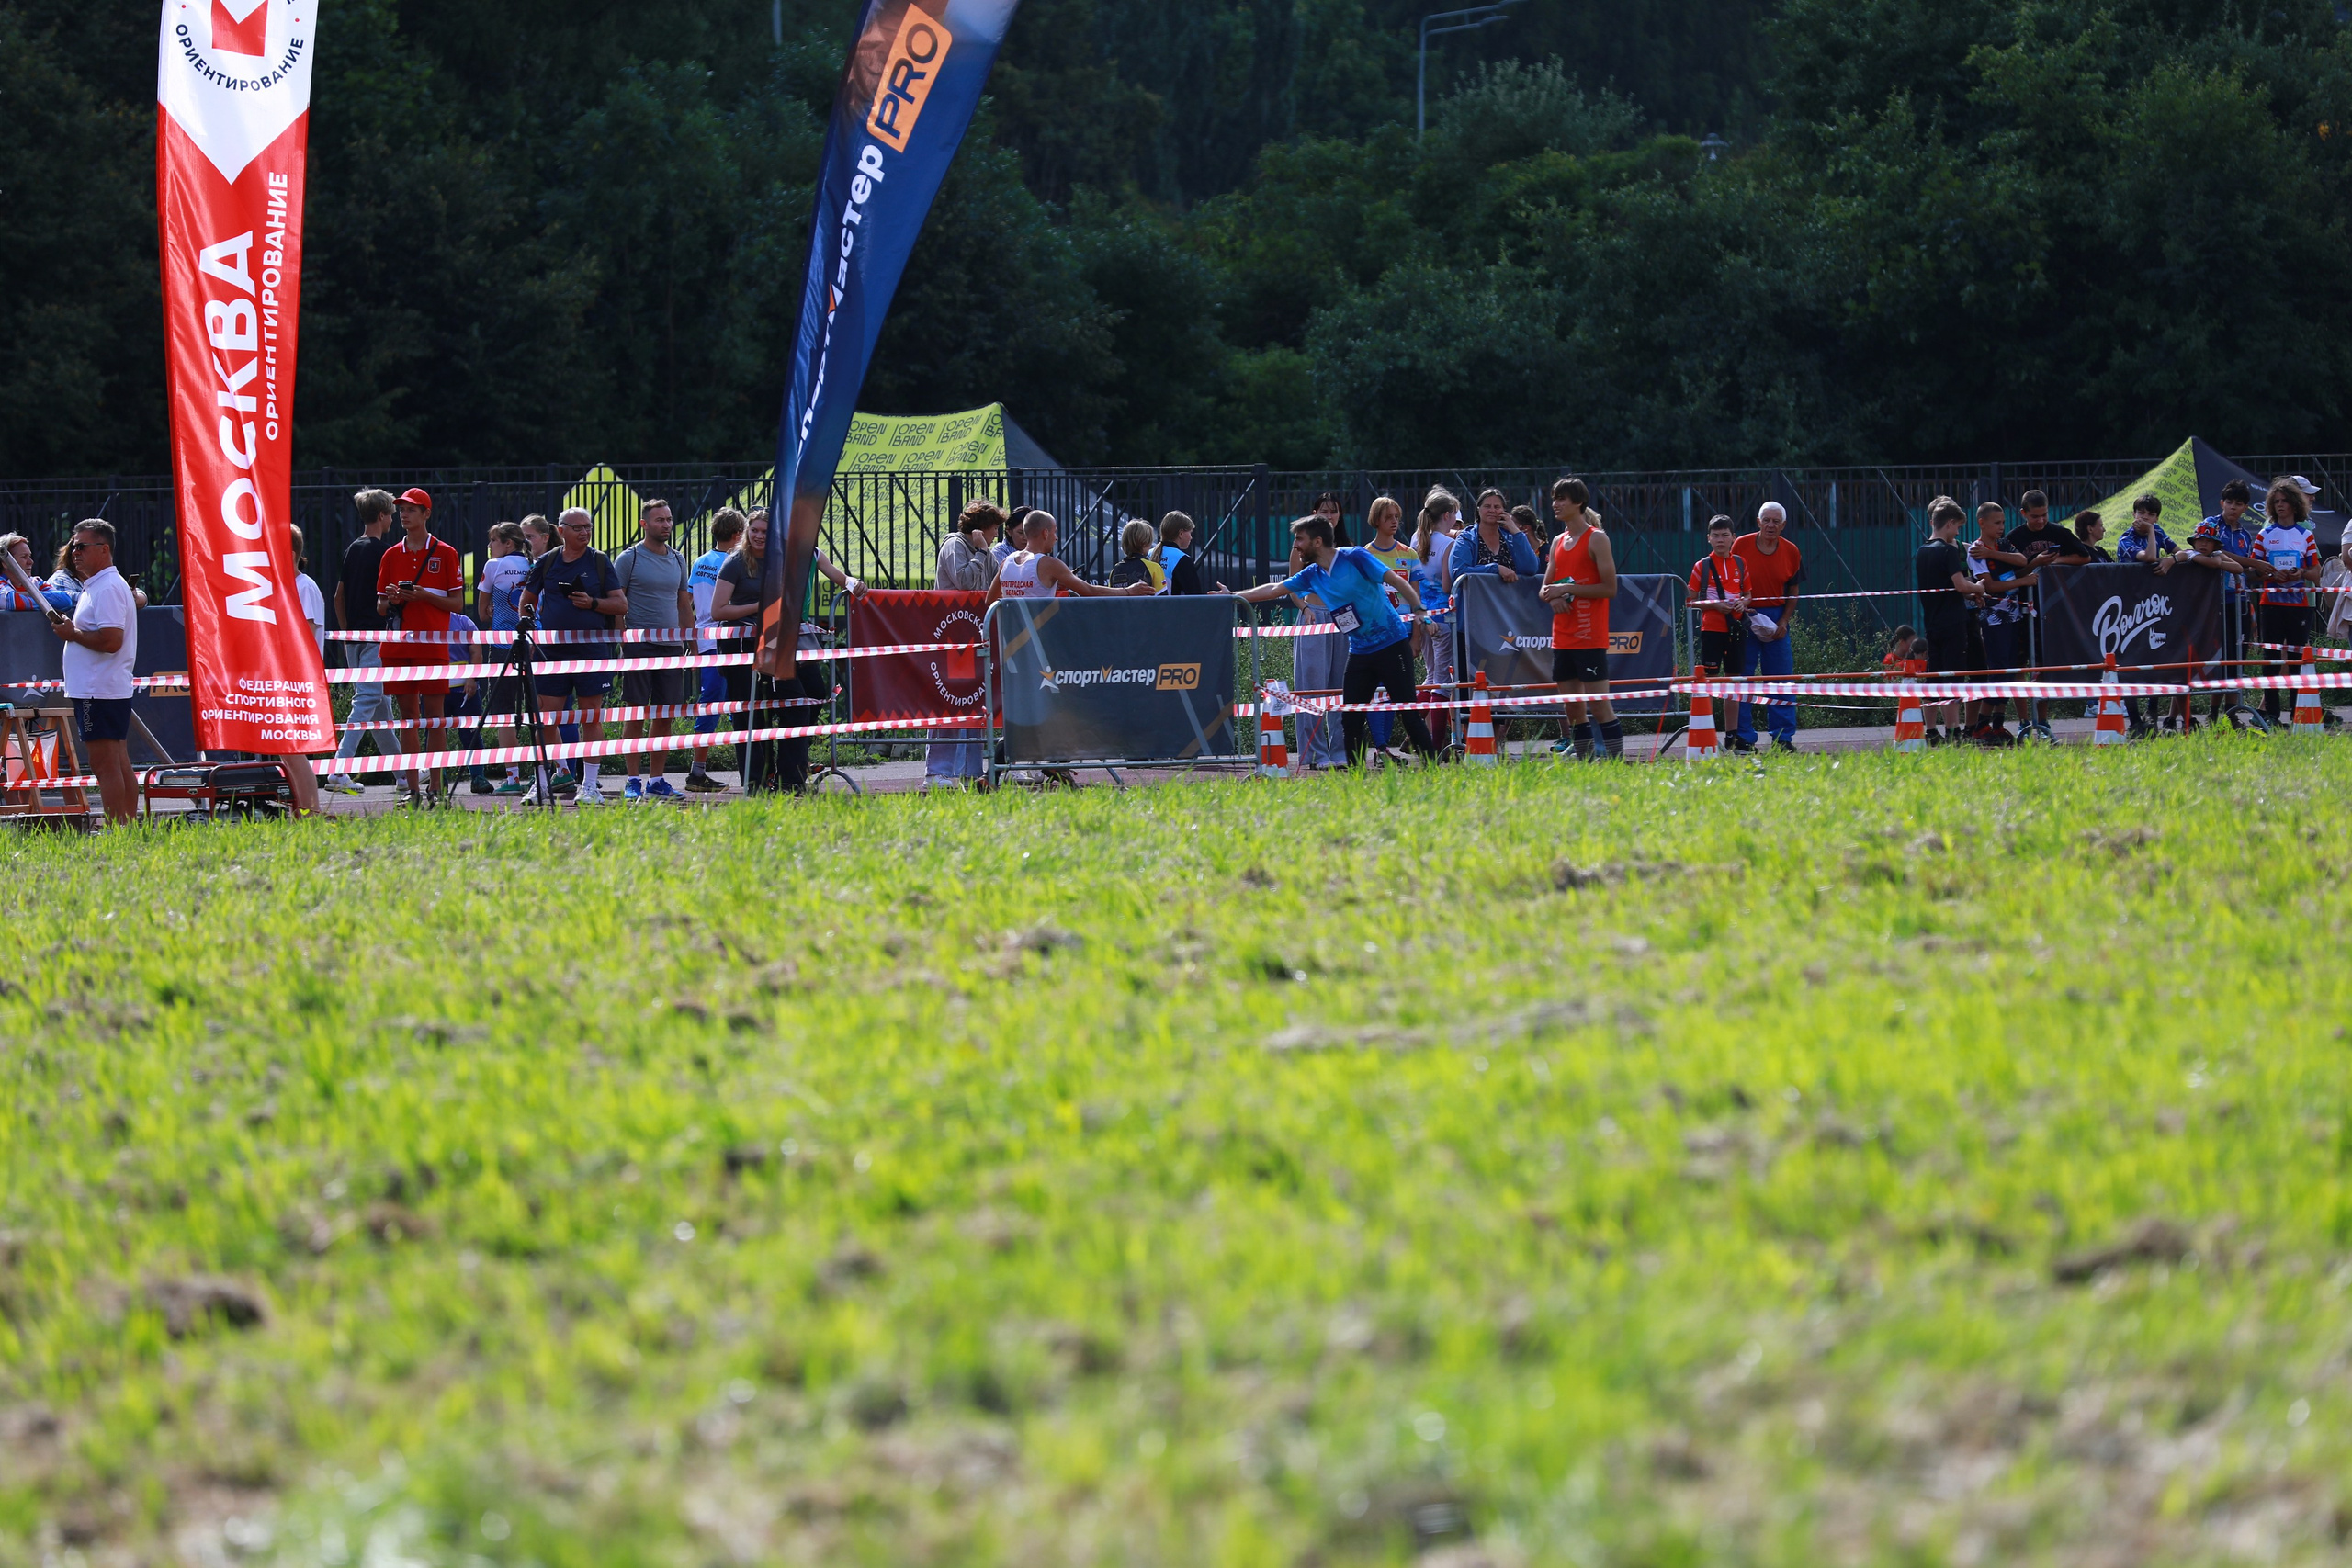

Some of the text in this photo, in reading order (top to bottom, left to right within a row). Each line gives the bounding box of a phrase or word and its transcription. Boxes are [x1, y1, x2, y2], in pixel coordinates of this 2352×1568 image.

[175, 24, 304, 92] ОРИЕНТИРОВАНИЕ
[874, 22, 938, 140] PRO
[262, 172, 288, 441] ОРИЕНТИРОВАНИЕ
[199, 230, 277, 626] МОСКВА
[239, 677, 314, 694] ФЕДЕРАЦИЯ
[1159, 667, 1197, 686] PRO
[225, 694, 317, 708] СПОРТИВНОГО
[201, 709, 319, 725] ОРИЕНТИРОВАНИЯ
[261, 729, 322, 740] МОСКВЫ
